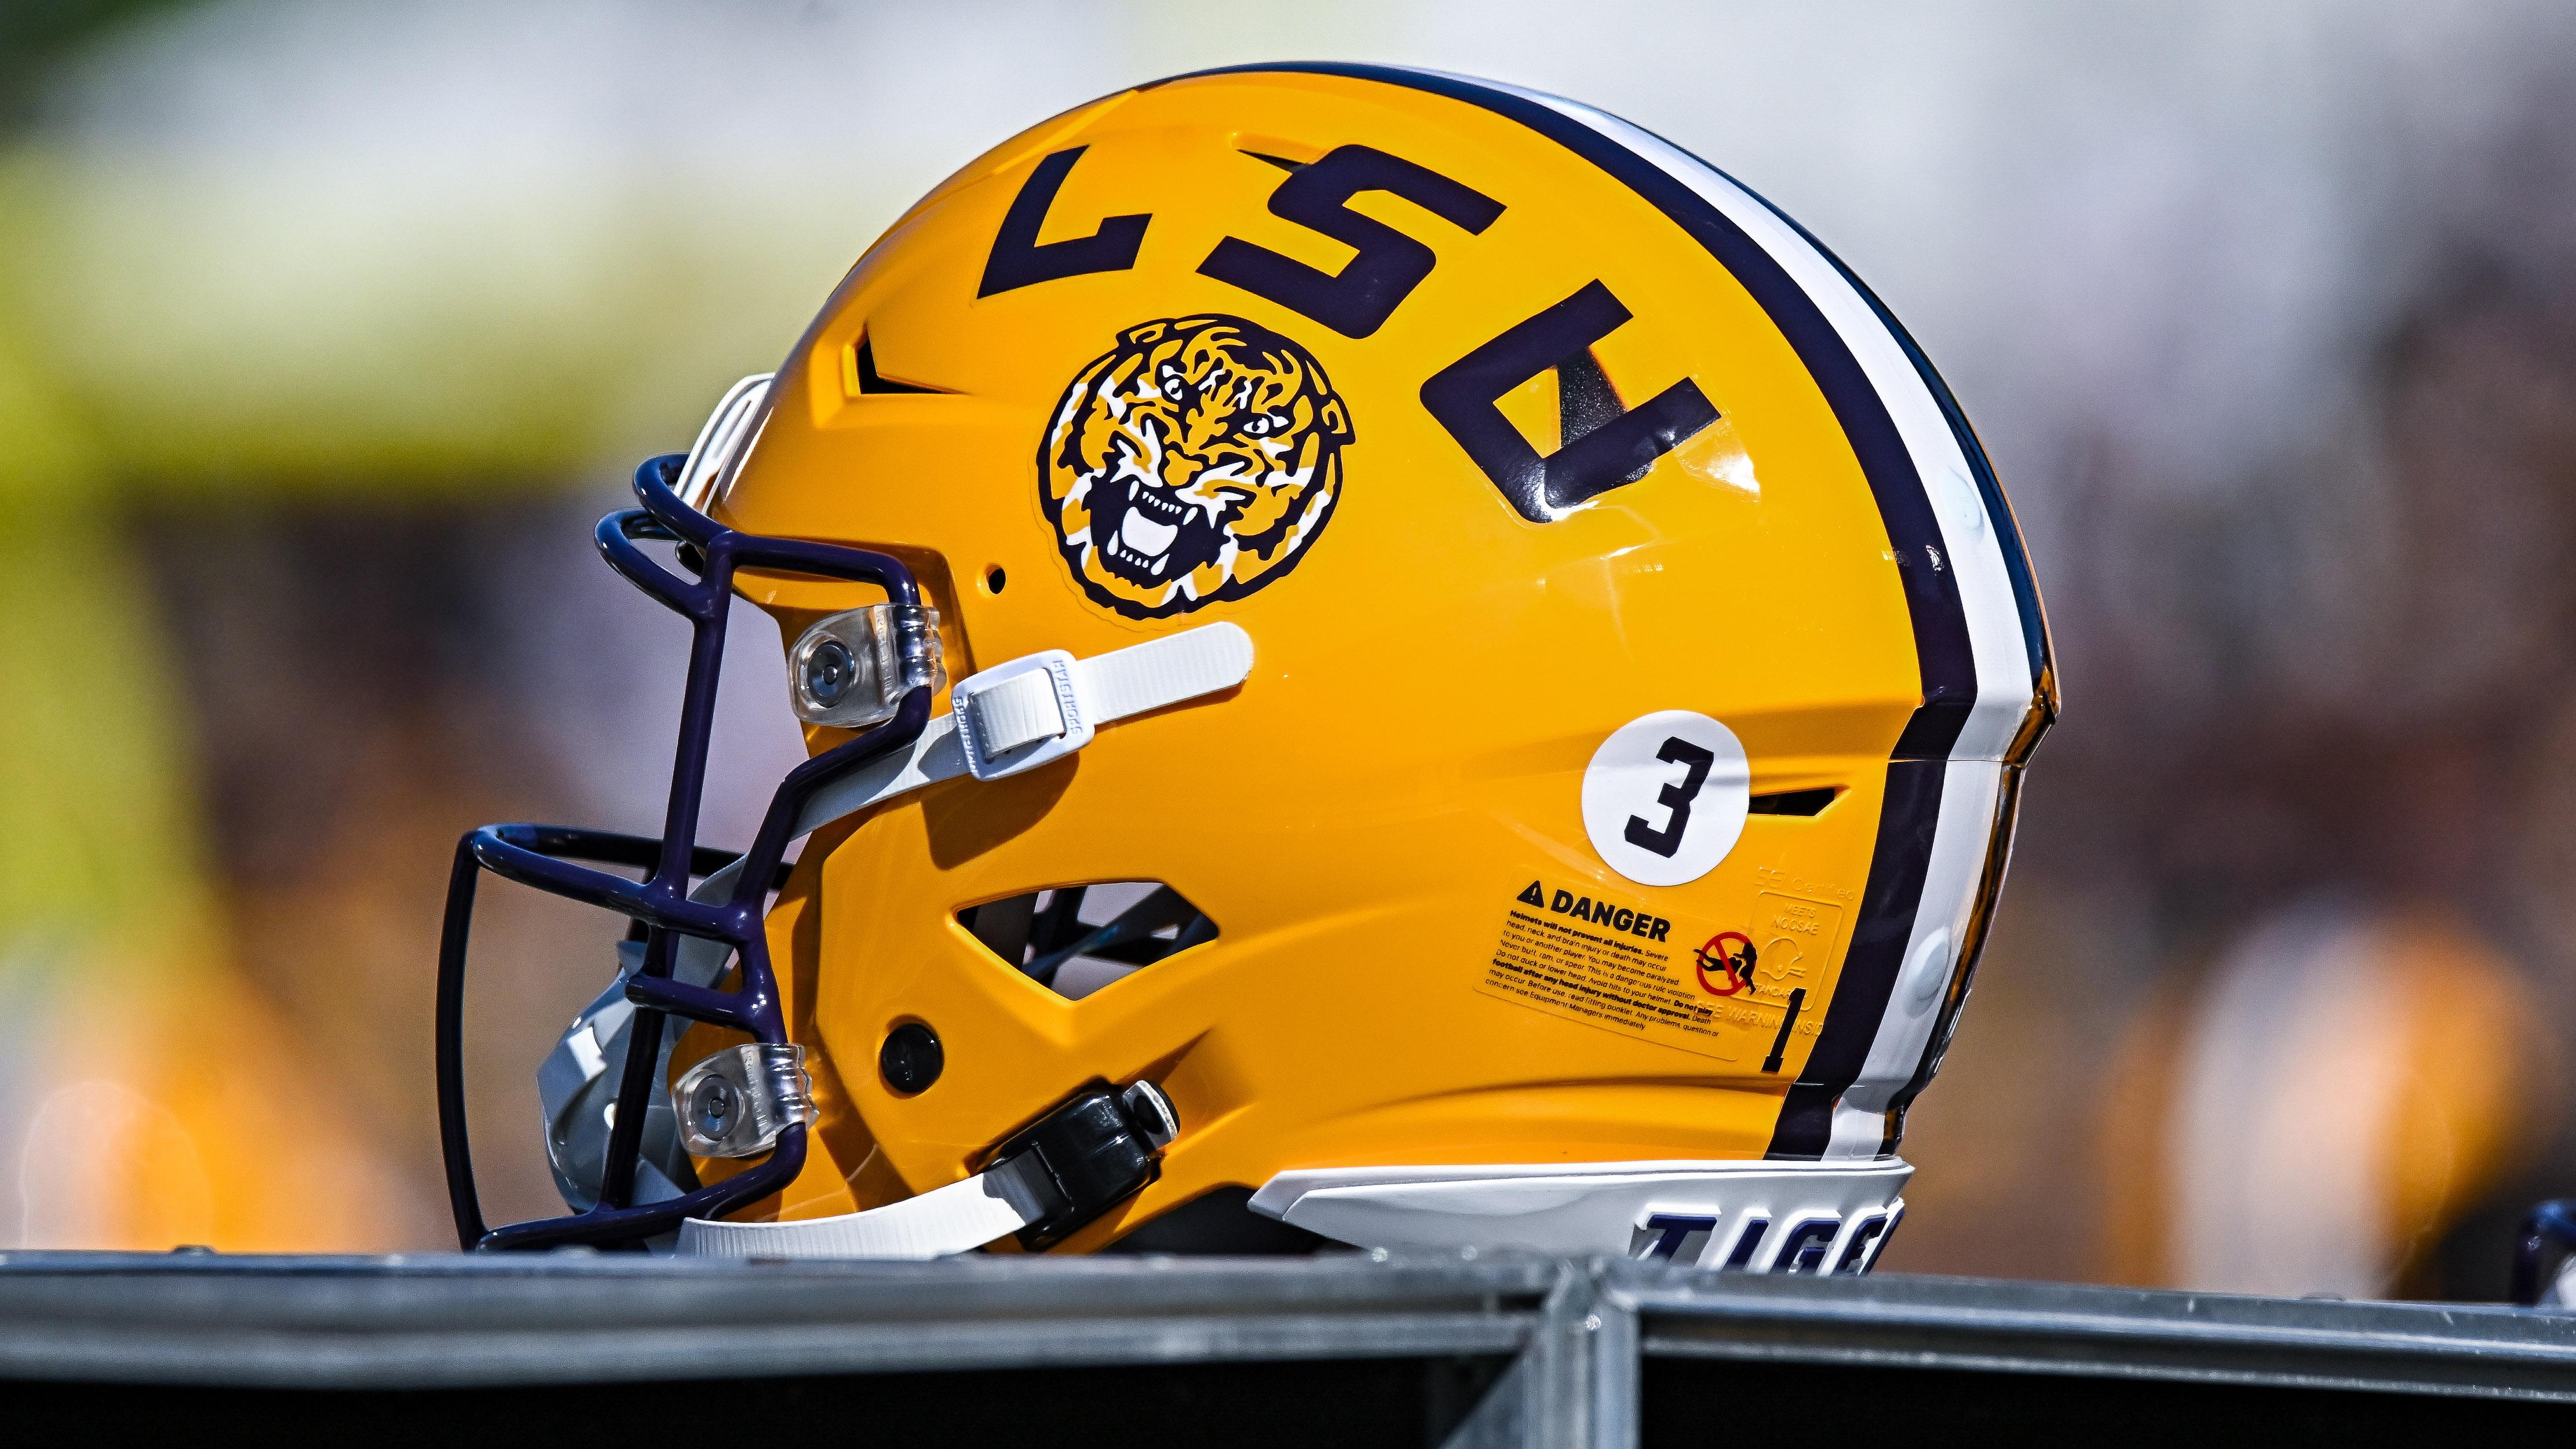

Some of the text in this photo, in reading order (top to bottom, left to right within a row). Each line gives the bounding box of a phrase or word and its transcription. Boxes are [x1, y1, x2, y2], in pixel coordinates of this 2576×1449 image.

[976, 144, 1722, 523] LSU
[1624, 736, 1714, 858] 3
[1550, 889, 1671, 943] DANGER
[1726, 1006, 1783, 1030] WARNIN
[1761, 987, 1807, 1073] 1
